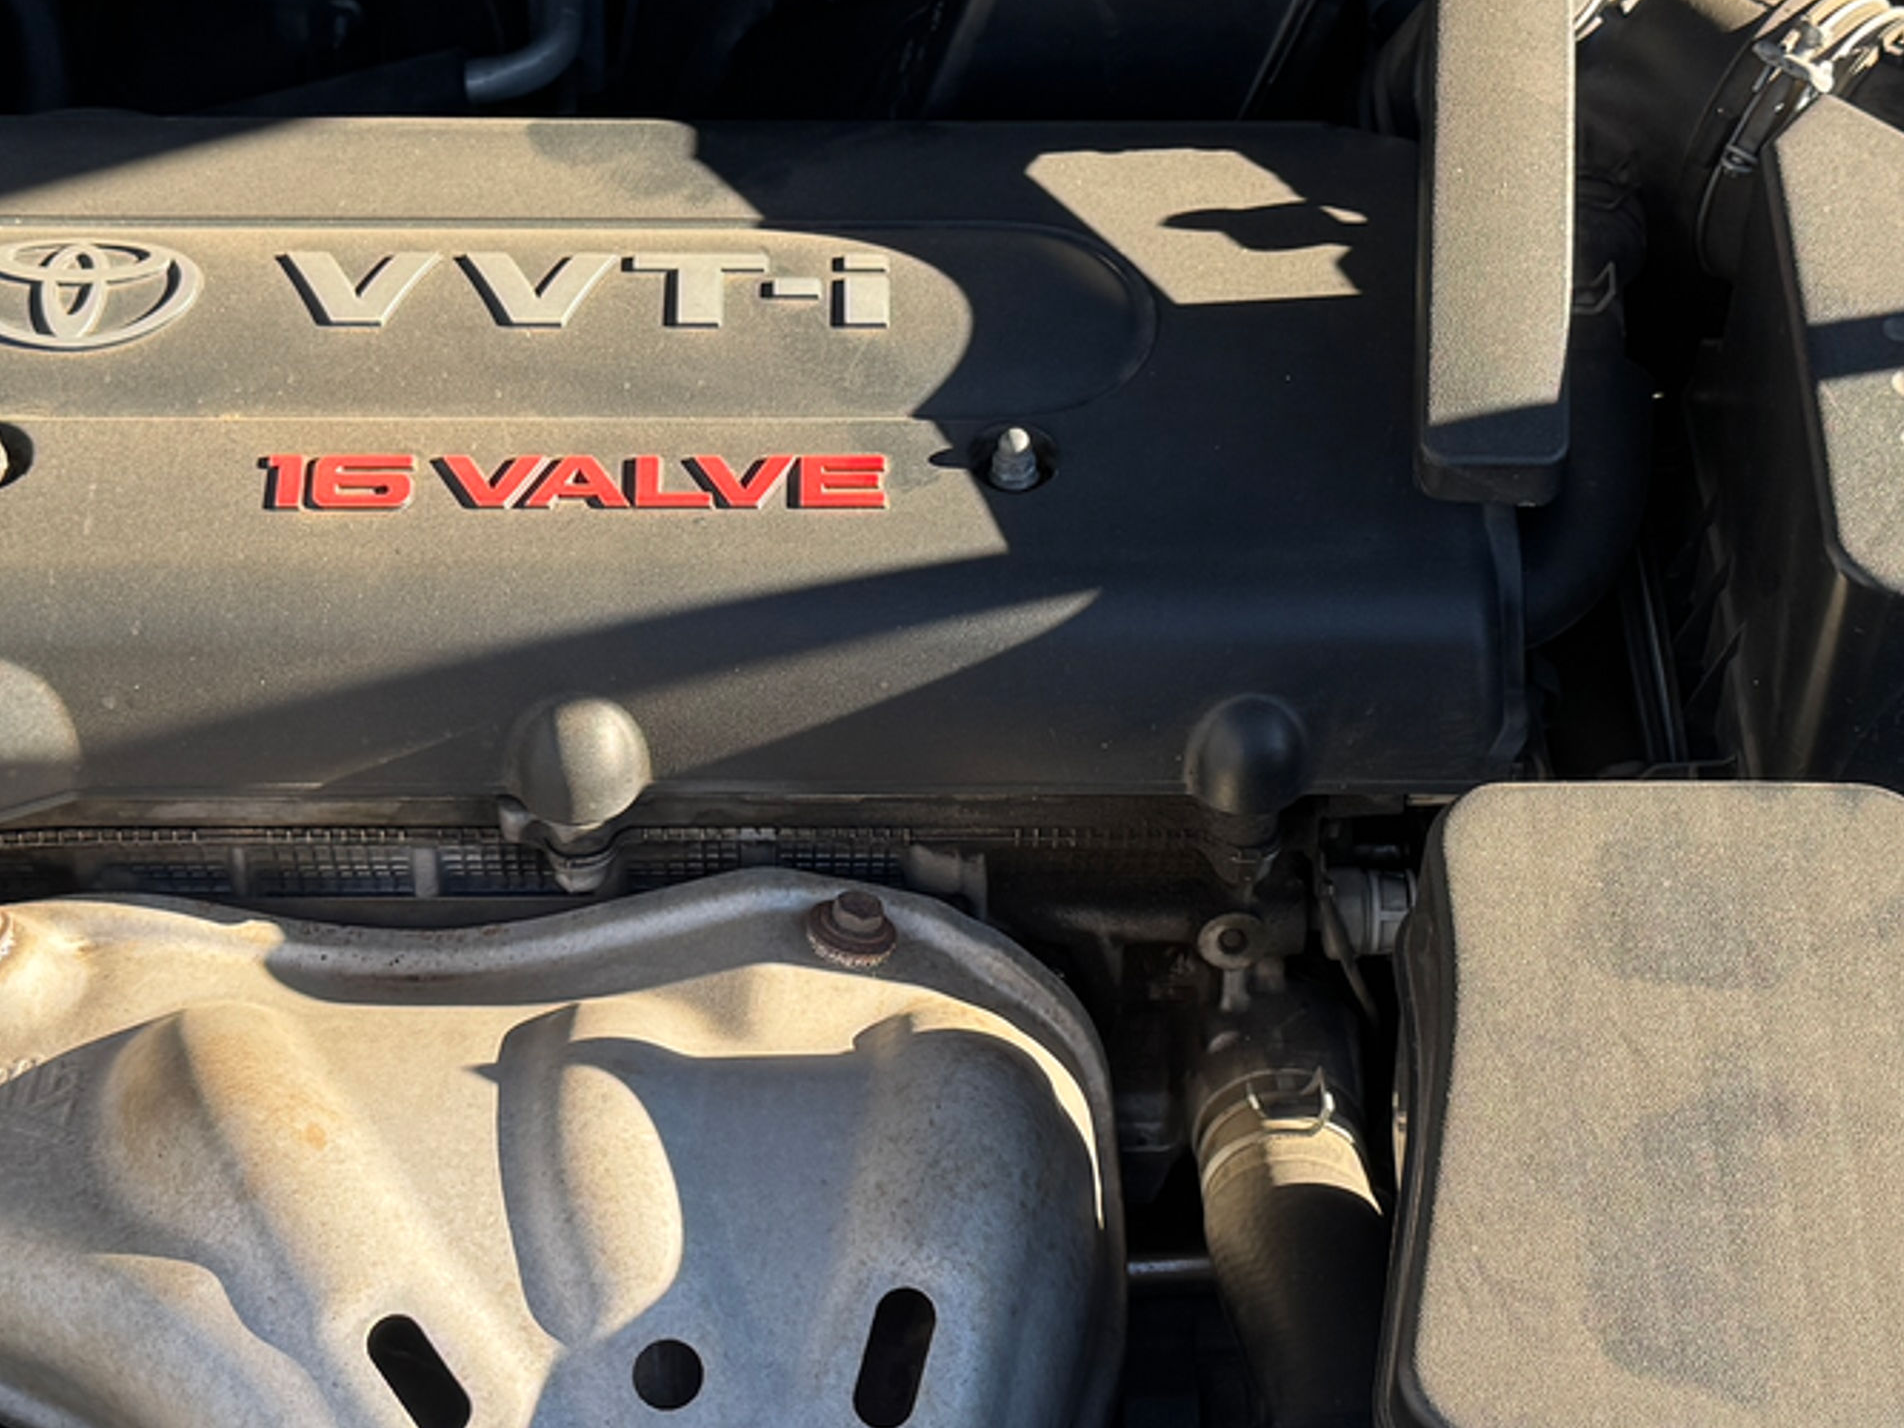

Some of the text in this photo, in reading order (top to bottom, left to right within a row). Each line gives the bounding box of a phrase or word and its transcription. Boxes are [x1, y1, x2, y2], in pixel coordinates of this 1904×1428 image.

[276, 251, 891, 330] VVT-i
[259, 453, 890, 510] 16 VALVE
